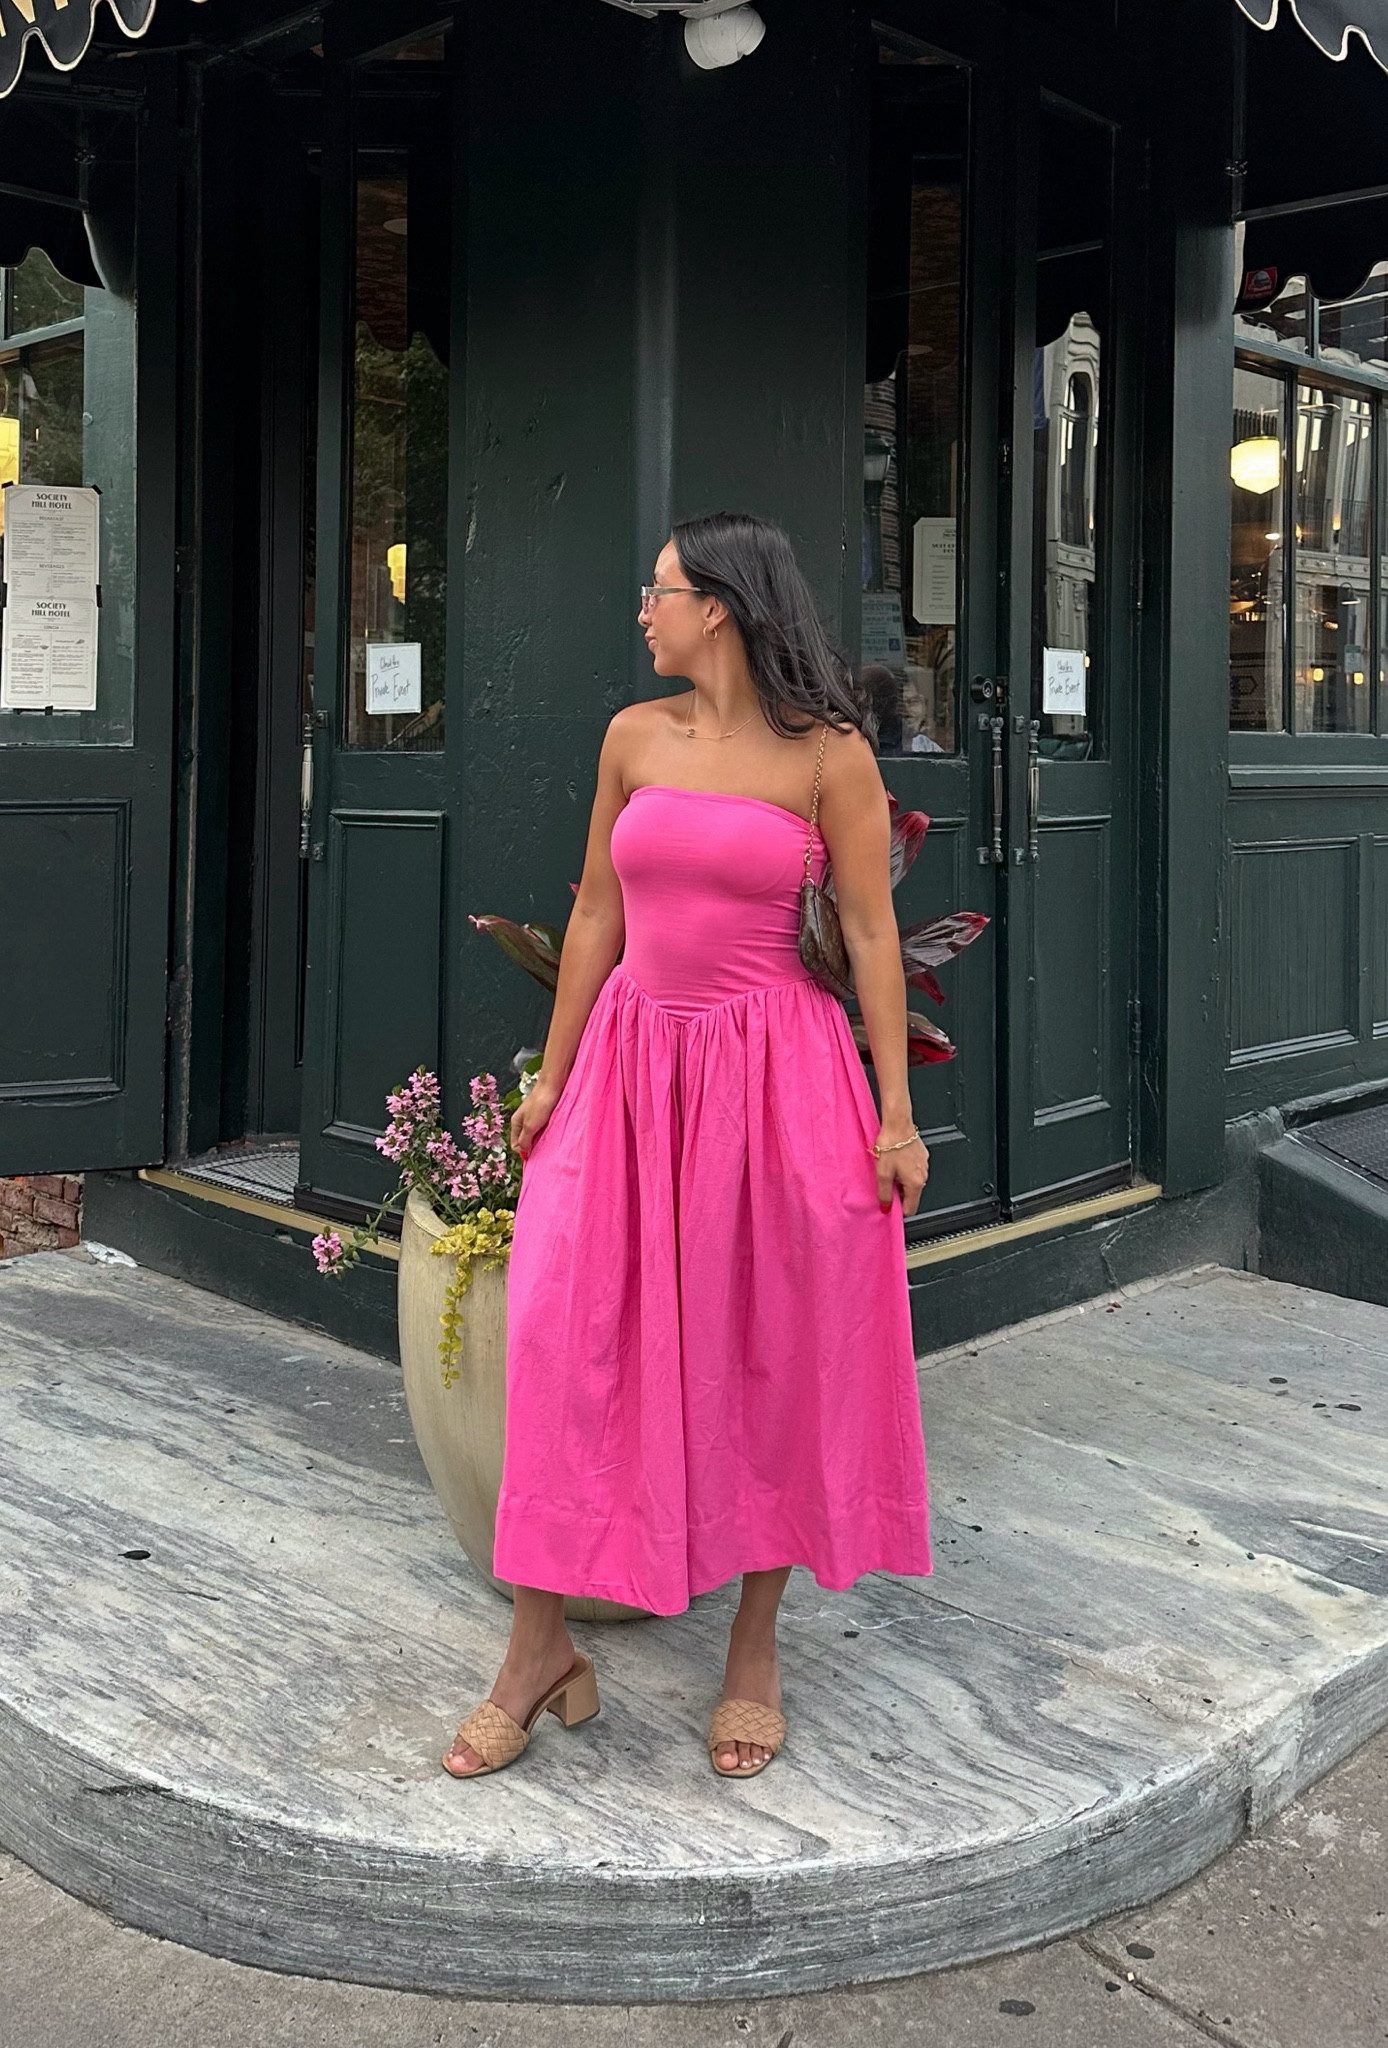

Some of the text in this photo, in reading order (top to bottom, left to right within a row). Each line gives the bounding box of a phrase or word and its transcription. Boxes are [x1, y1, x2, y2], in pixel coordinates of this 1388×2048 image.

[36, 493, 67, 501] SOCIETY
[32, 500, 72, 509] HILL HOTEL
[393, 672, 412, 702] Event
